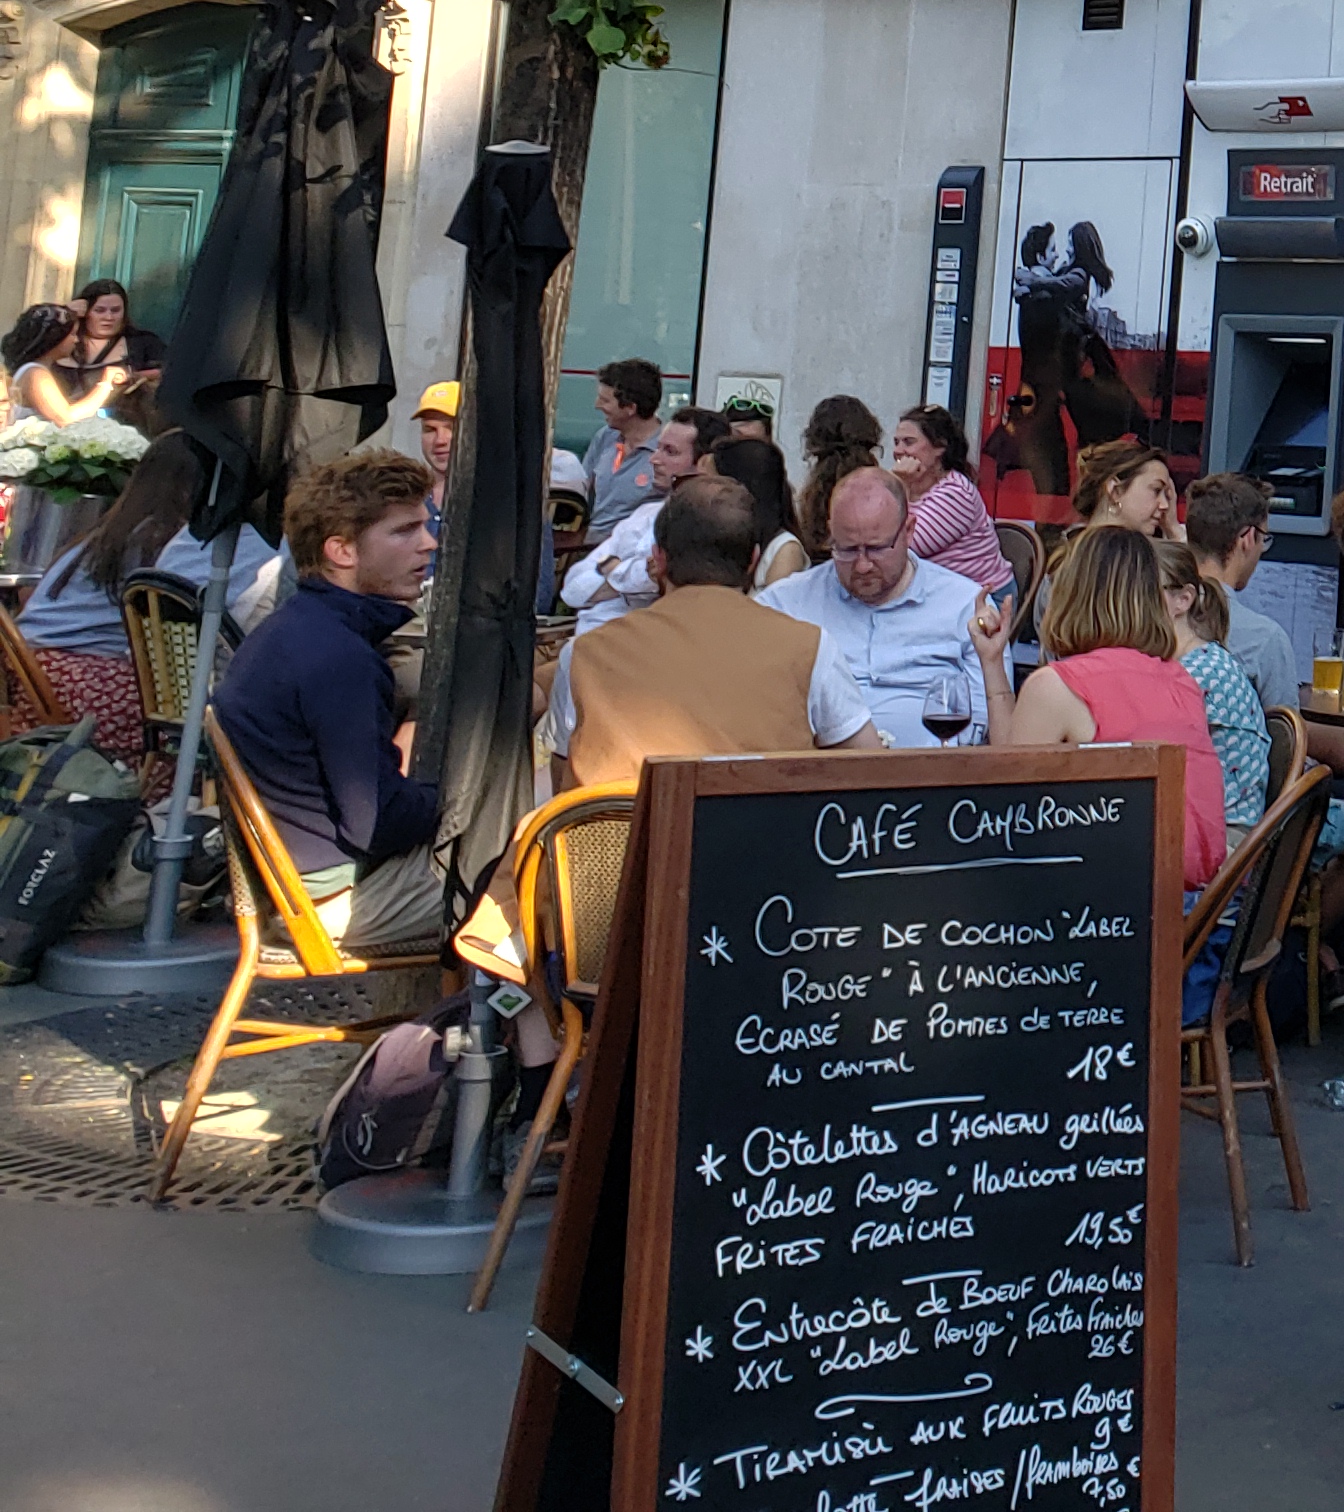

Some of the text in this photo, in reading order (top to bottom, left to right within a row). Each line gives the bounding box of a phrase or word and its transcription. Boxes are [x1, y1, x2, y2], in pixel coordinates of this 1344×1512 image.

[1260, 172, 1314, 193] Retrait
[949, 796, 1125, 851] CAMBRONNE
[882, 923, 928, 949] DE
[941, 919, 1054, 946] COCHON
[870, 1018, 908, 1045] DE
[1057, 1006, 1125, 1028] TERRE
[767, 1063, 801, 1087] AU
[820, 1052, 915, 1081] CANTAL
[1086, 1155, 1146, 1180] VERTS
[916, 1282, 951, 1318] de
[733, 1360, 794, 1393] XXL
